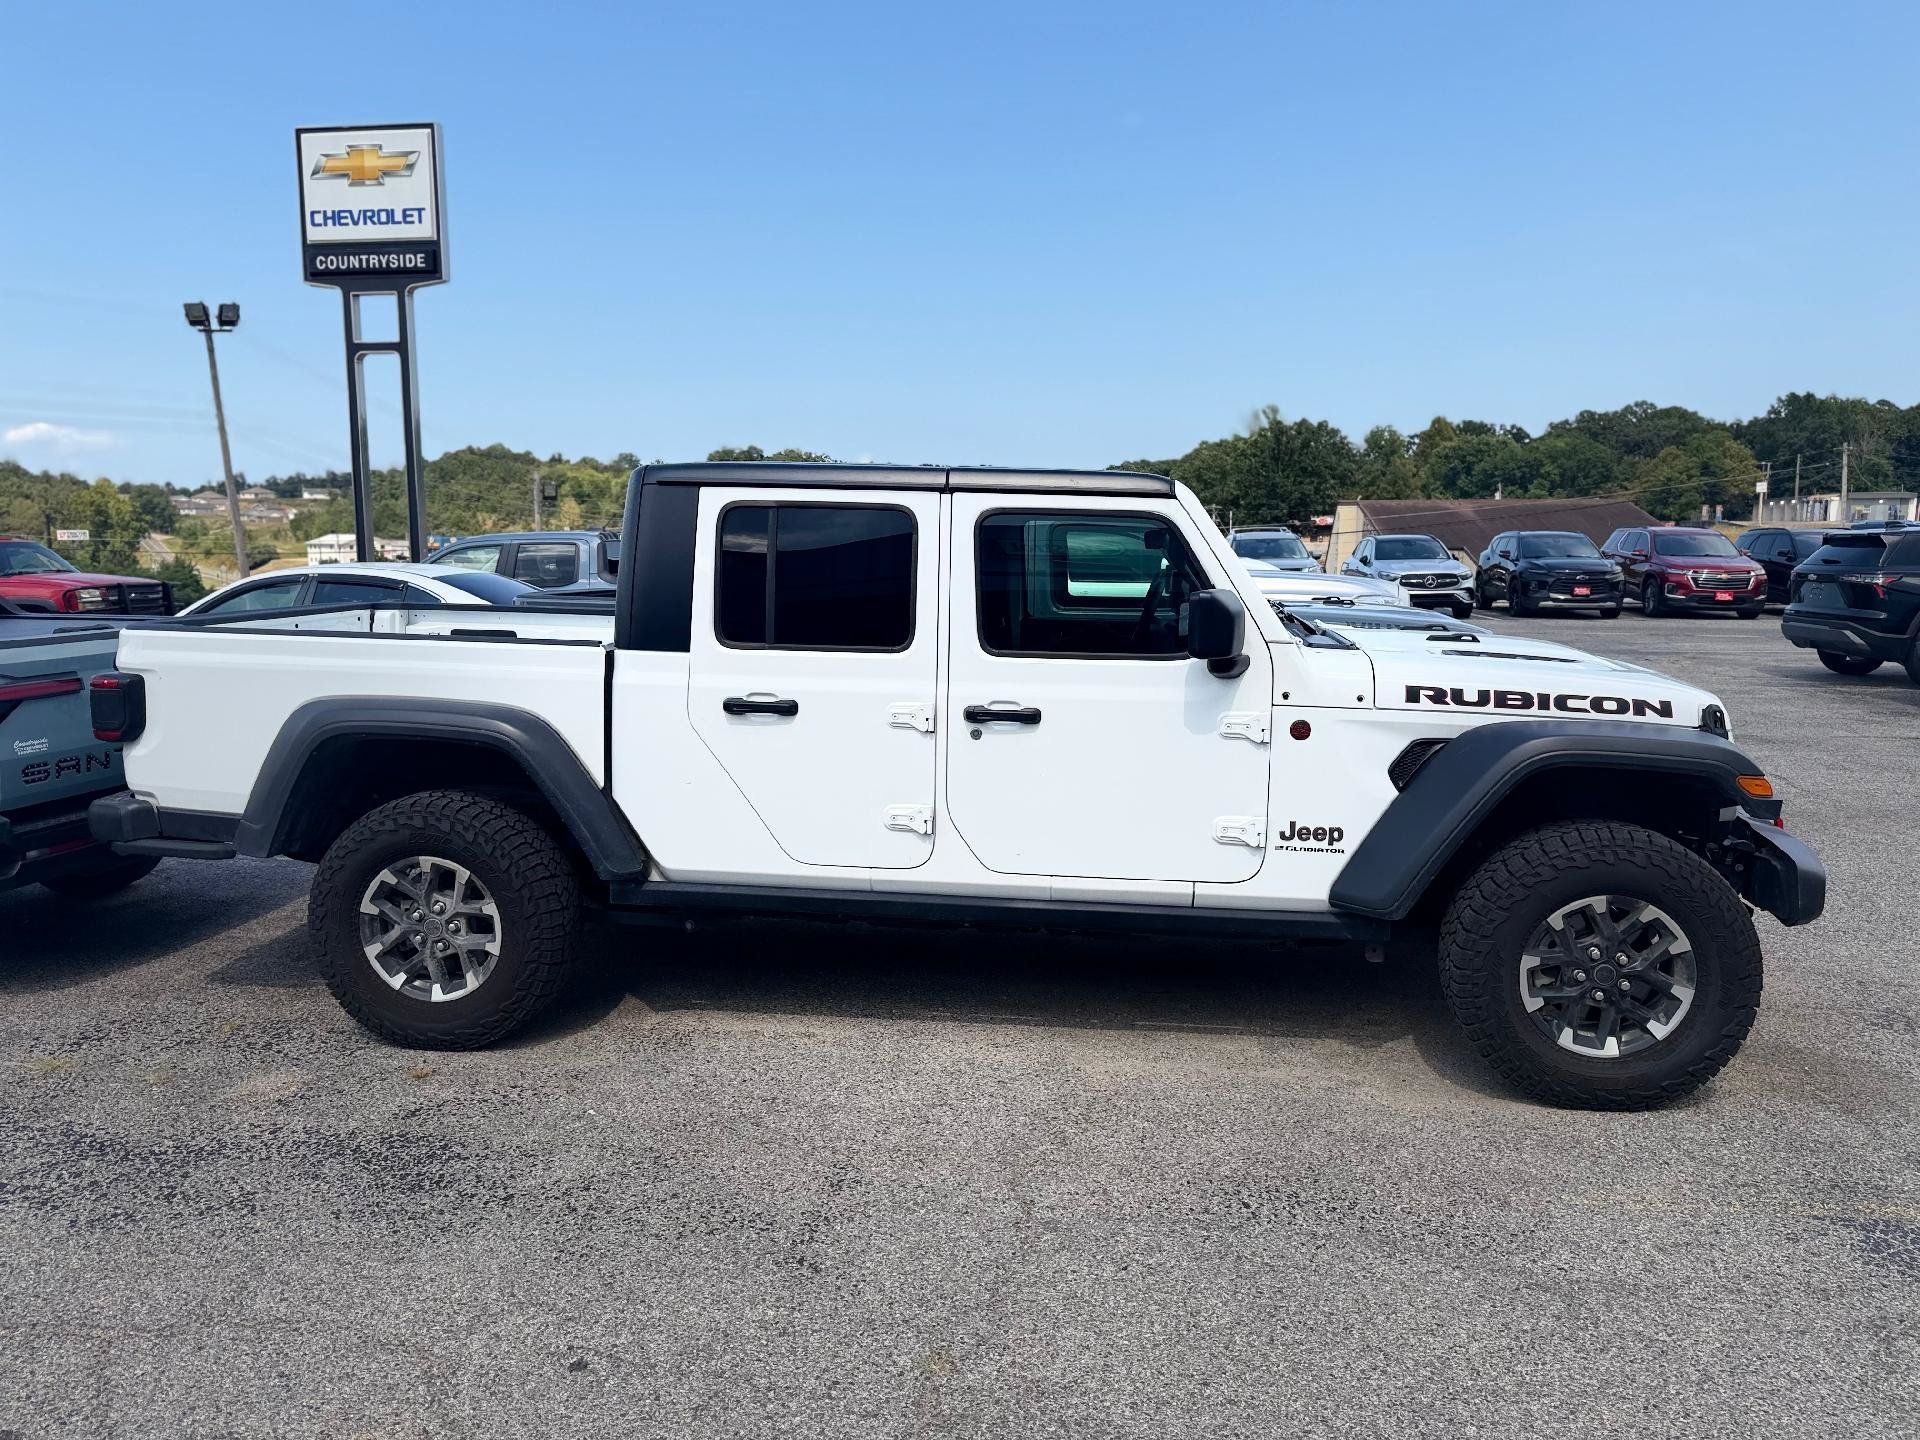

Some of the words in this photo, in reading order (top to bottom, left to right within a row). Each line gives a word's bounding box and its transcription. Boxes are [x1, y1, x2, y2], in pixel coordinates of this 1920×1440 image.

[310, 207, 425, 227] CHEVROLET
[316, 253, 426, 270] COUNTRYSIDE
[1404, 684, 1674, 718] RUBICON
[21, 749, 123, 785] SAN
[1279, 820, 1344, 846] Jeep
[1285, 845, 1345, 854] GLADIATOR
